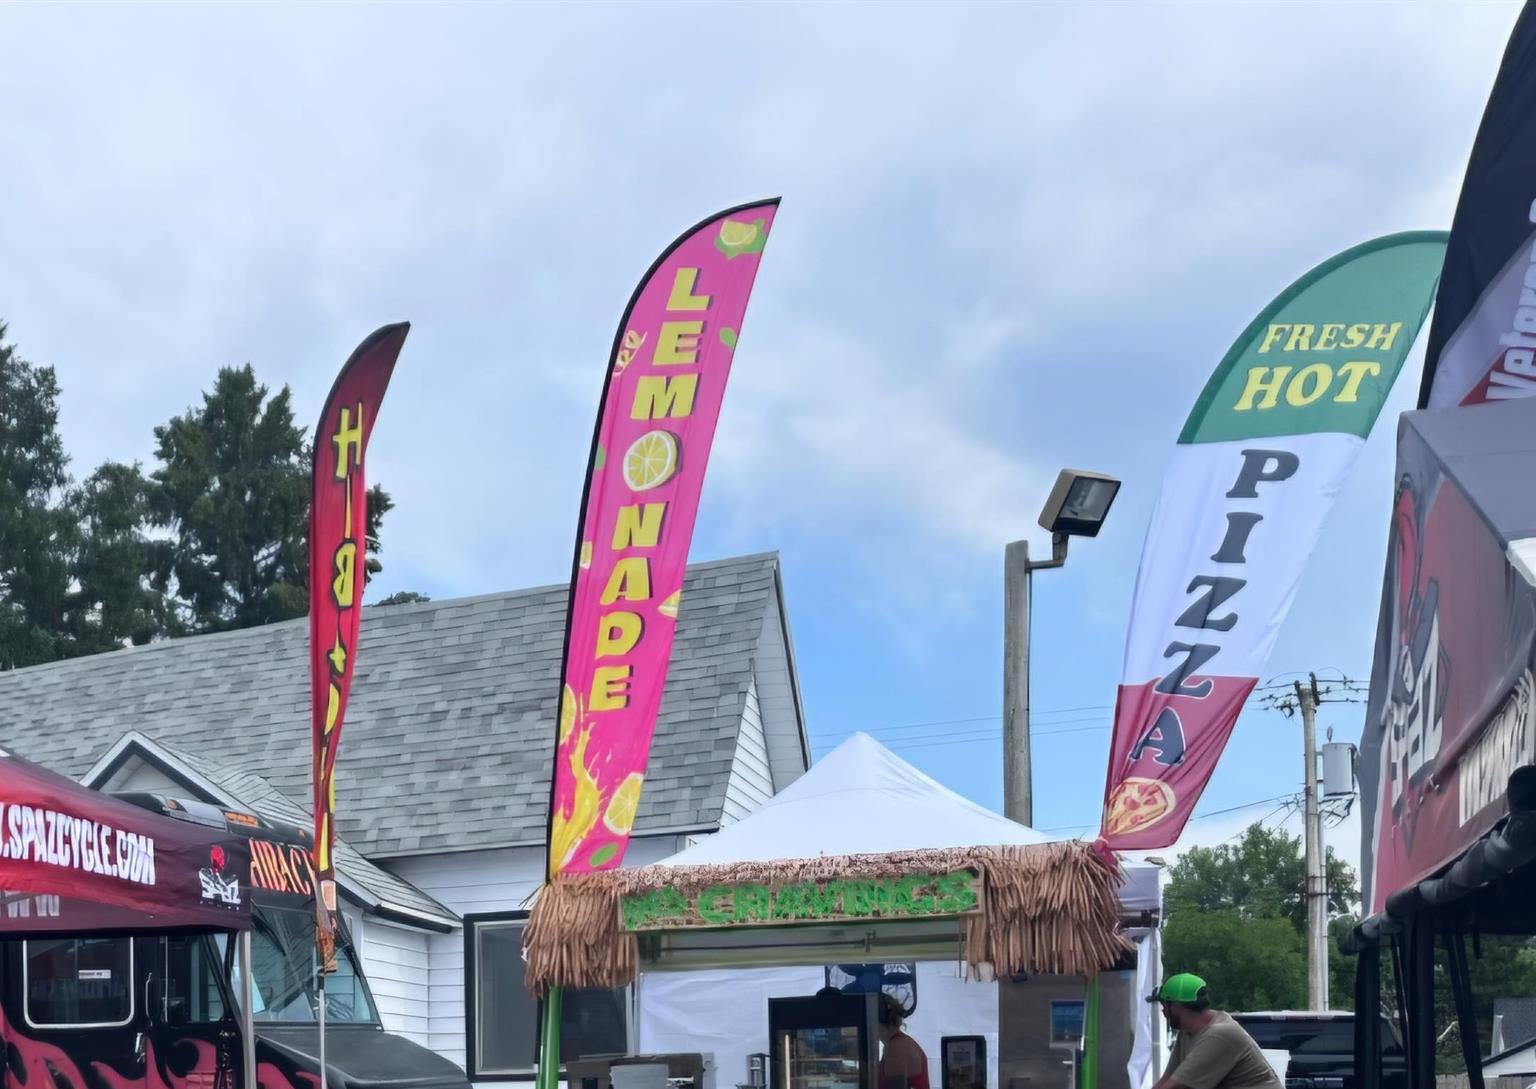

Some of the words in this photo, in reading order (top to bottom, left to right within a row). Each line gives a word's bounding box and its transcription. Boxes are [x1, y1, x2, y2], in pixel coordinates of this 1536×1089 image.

[1233, 361, 1381, 412] HOT
[1257, 321, 1402, 356] FRESH
[588, 267, 711, 713] LEMONADE
[1130, 448, 1300, 767] PIZZA
